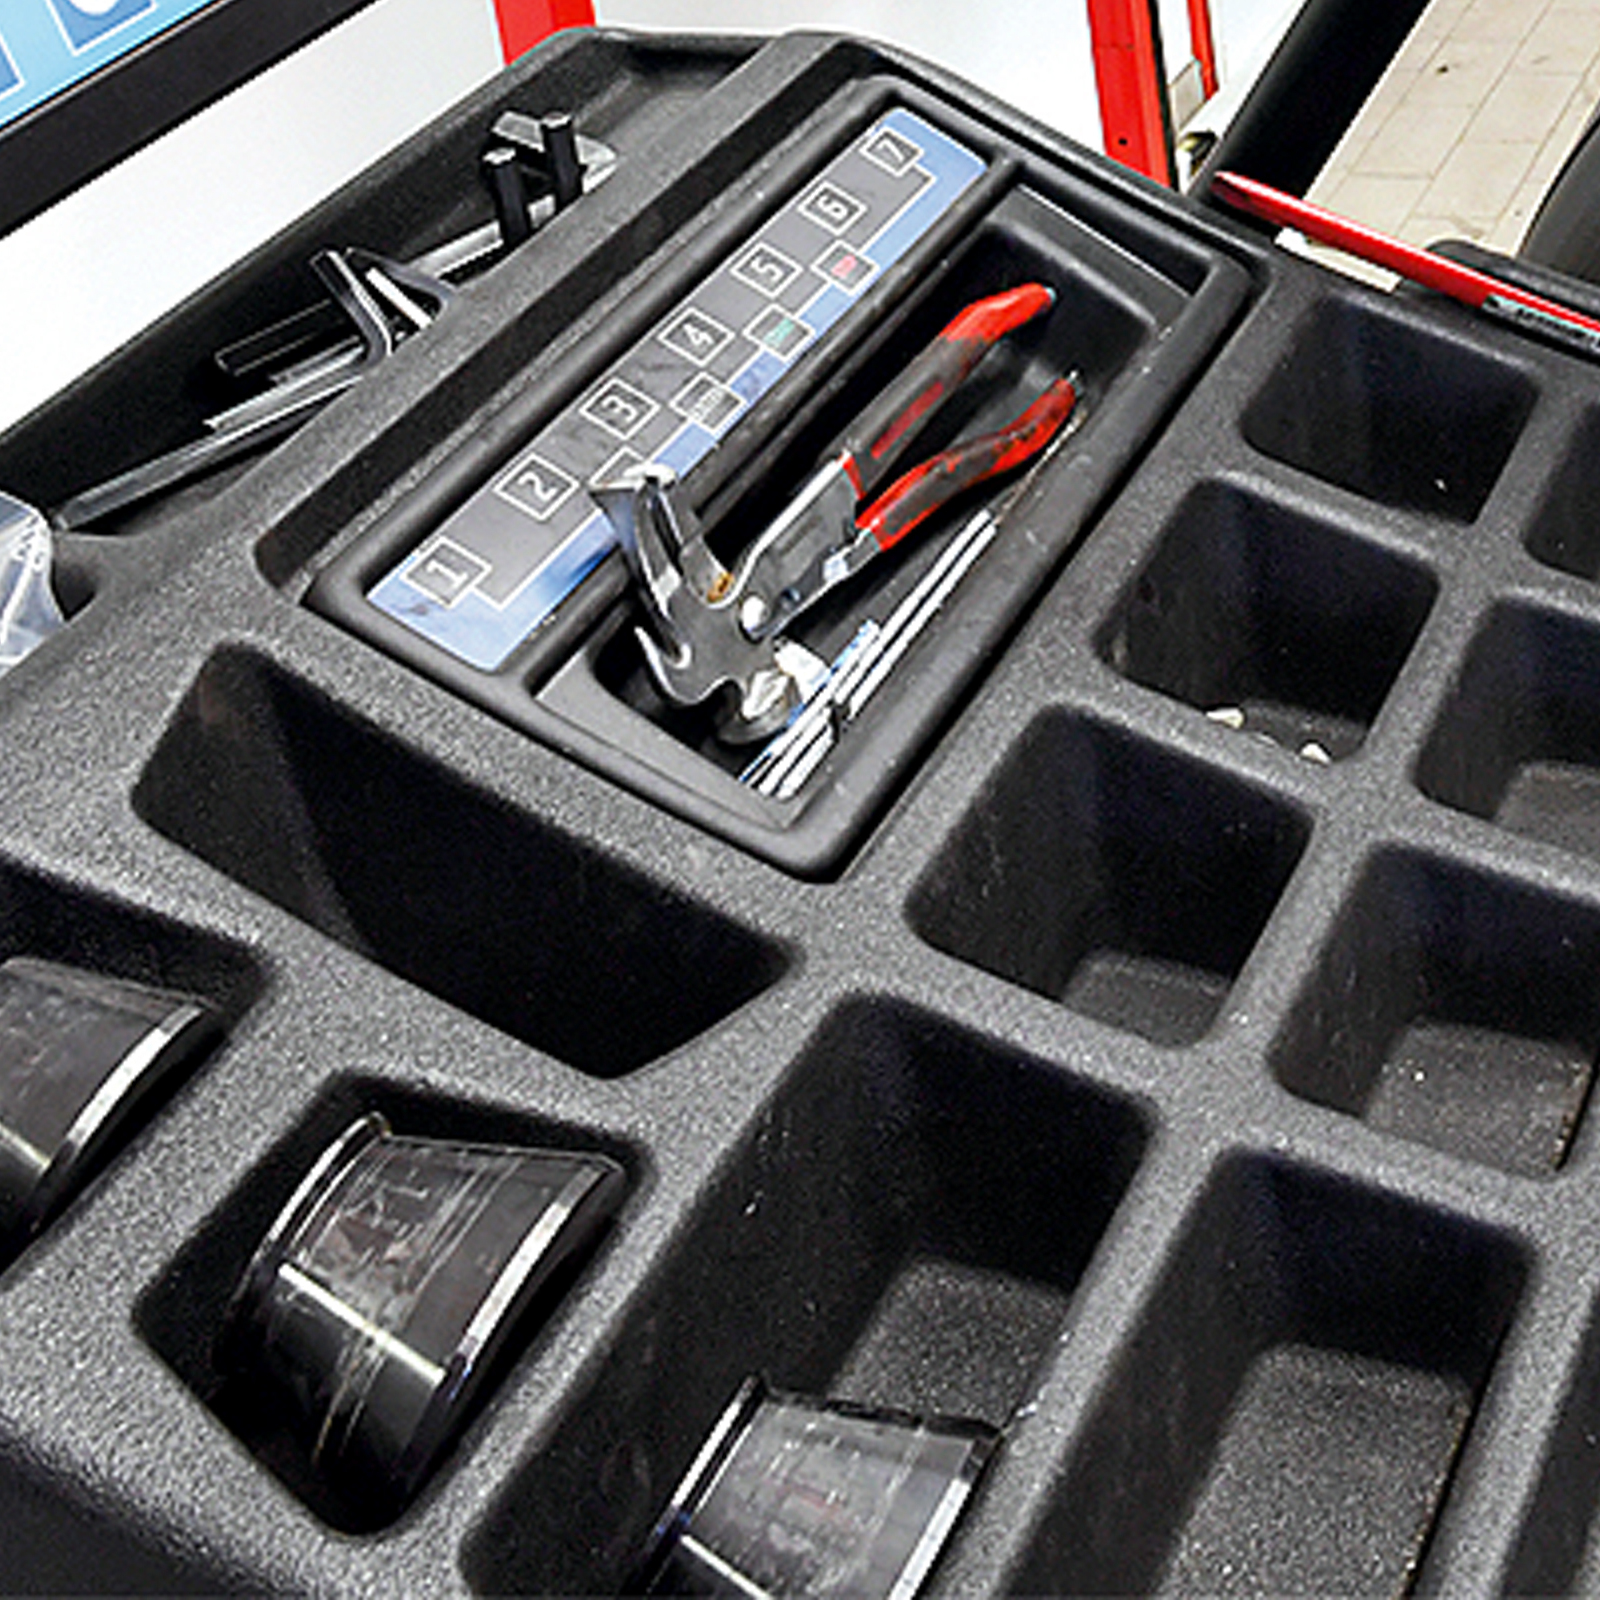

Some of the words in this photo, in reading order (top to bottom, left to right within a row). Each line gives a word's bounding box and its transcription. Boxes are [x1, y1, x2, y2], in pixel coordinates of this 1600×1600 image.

[875, 138, 905, 162] 7
[816, 194, 849, 219] 6
[750, 255, 784, 282] 5
[683, 322, 714, 346] 4
[602, 396, 638, 423] 3
[517, 471, 558, 501] 2
[426, 559, 469, 595] 1
